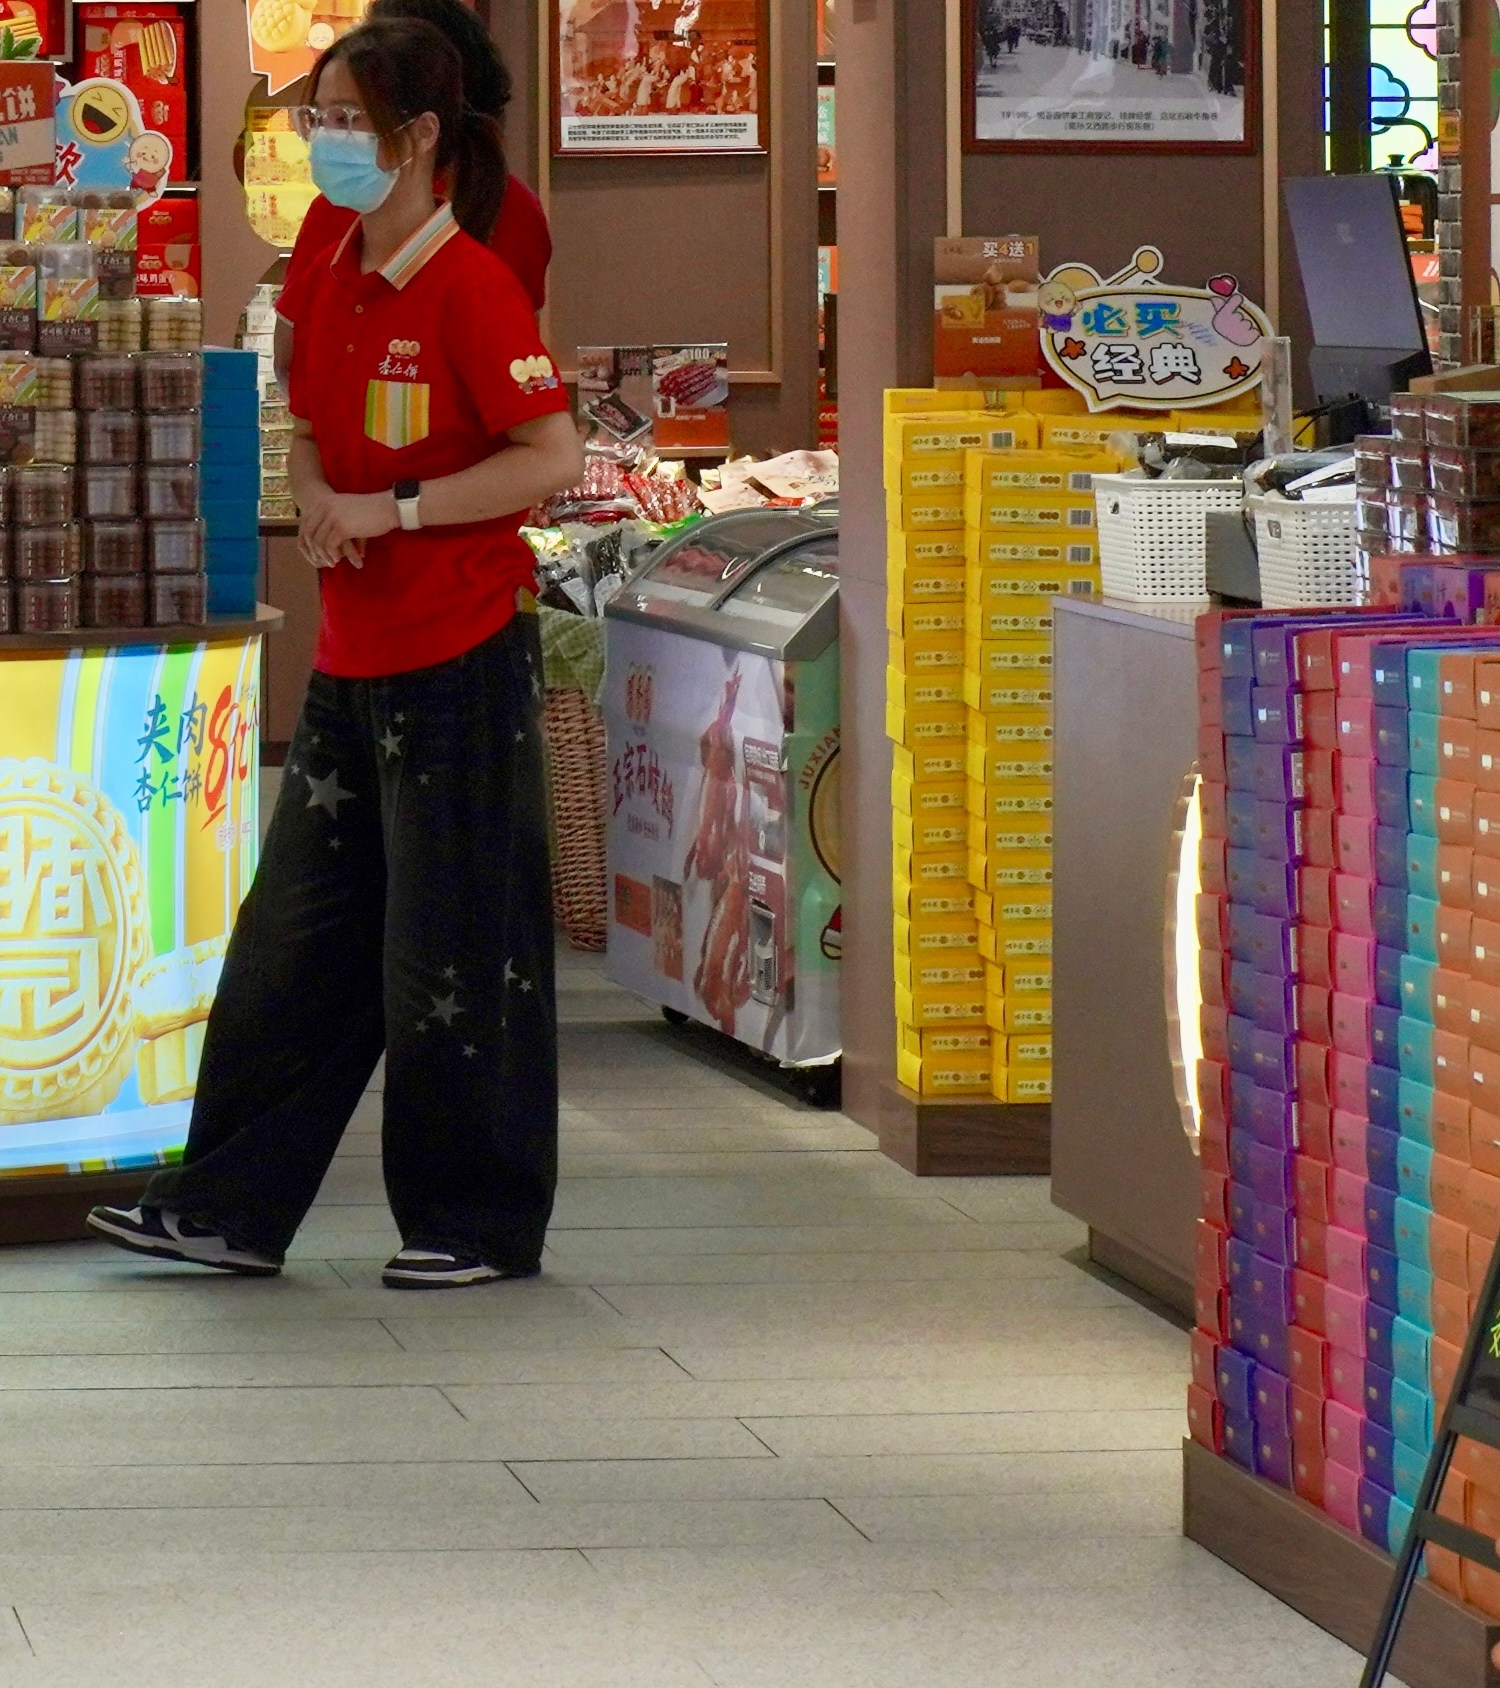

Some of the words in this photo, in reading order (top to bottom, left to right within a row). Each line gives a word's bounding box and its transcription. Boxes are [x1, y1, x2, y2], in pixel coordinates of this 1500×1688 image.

[983, 241, 1035, 258] 买4送1
[1082, 302, 1183, 338] 必买
[1091, 342, 1201, 384] 经典
[134, 691, 208, 763] 夹肉
[131, 764, 203, 812] 杏仁饼
